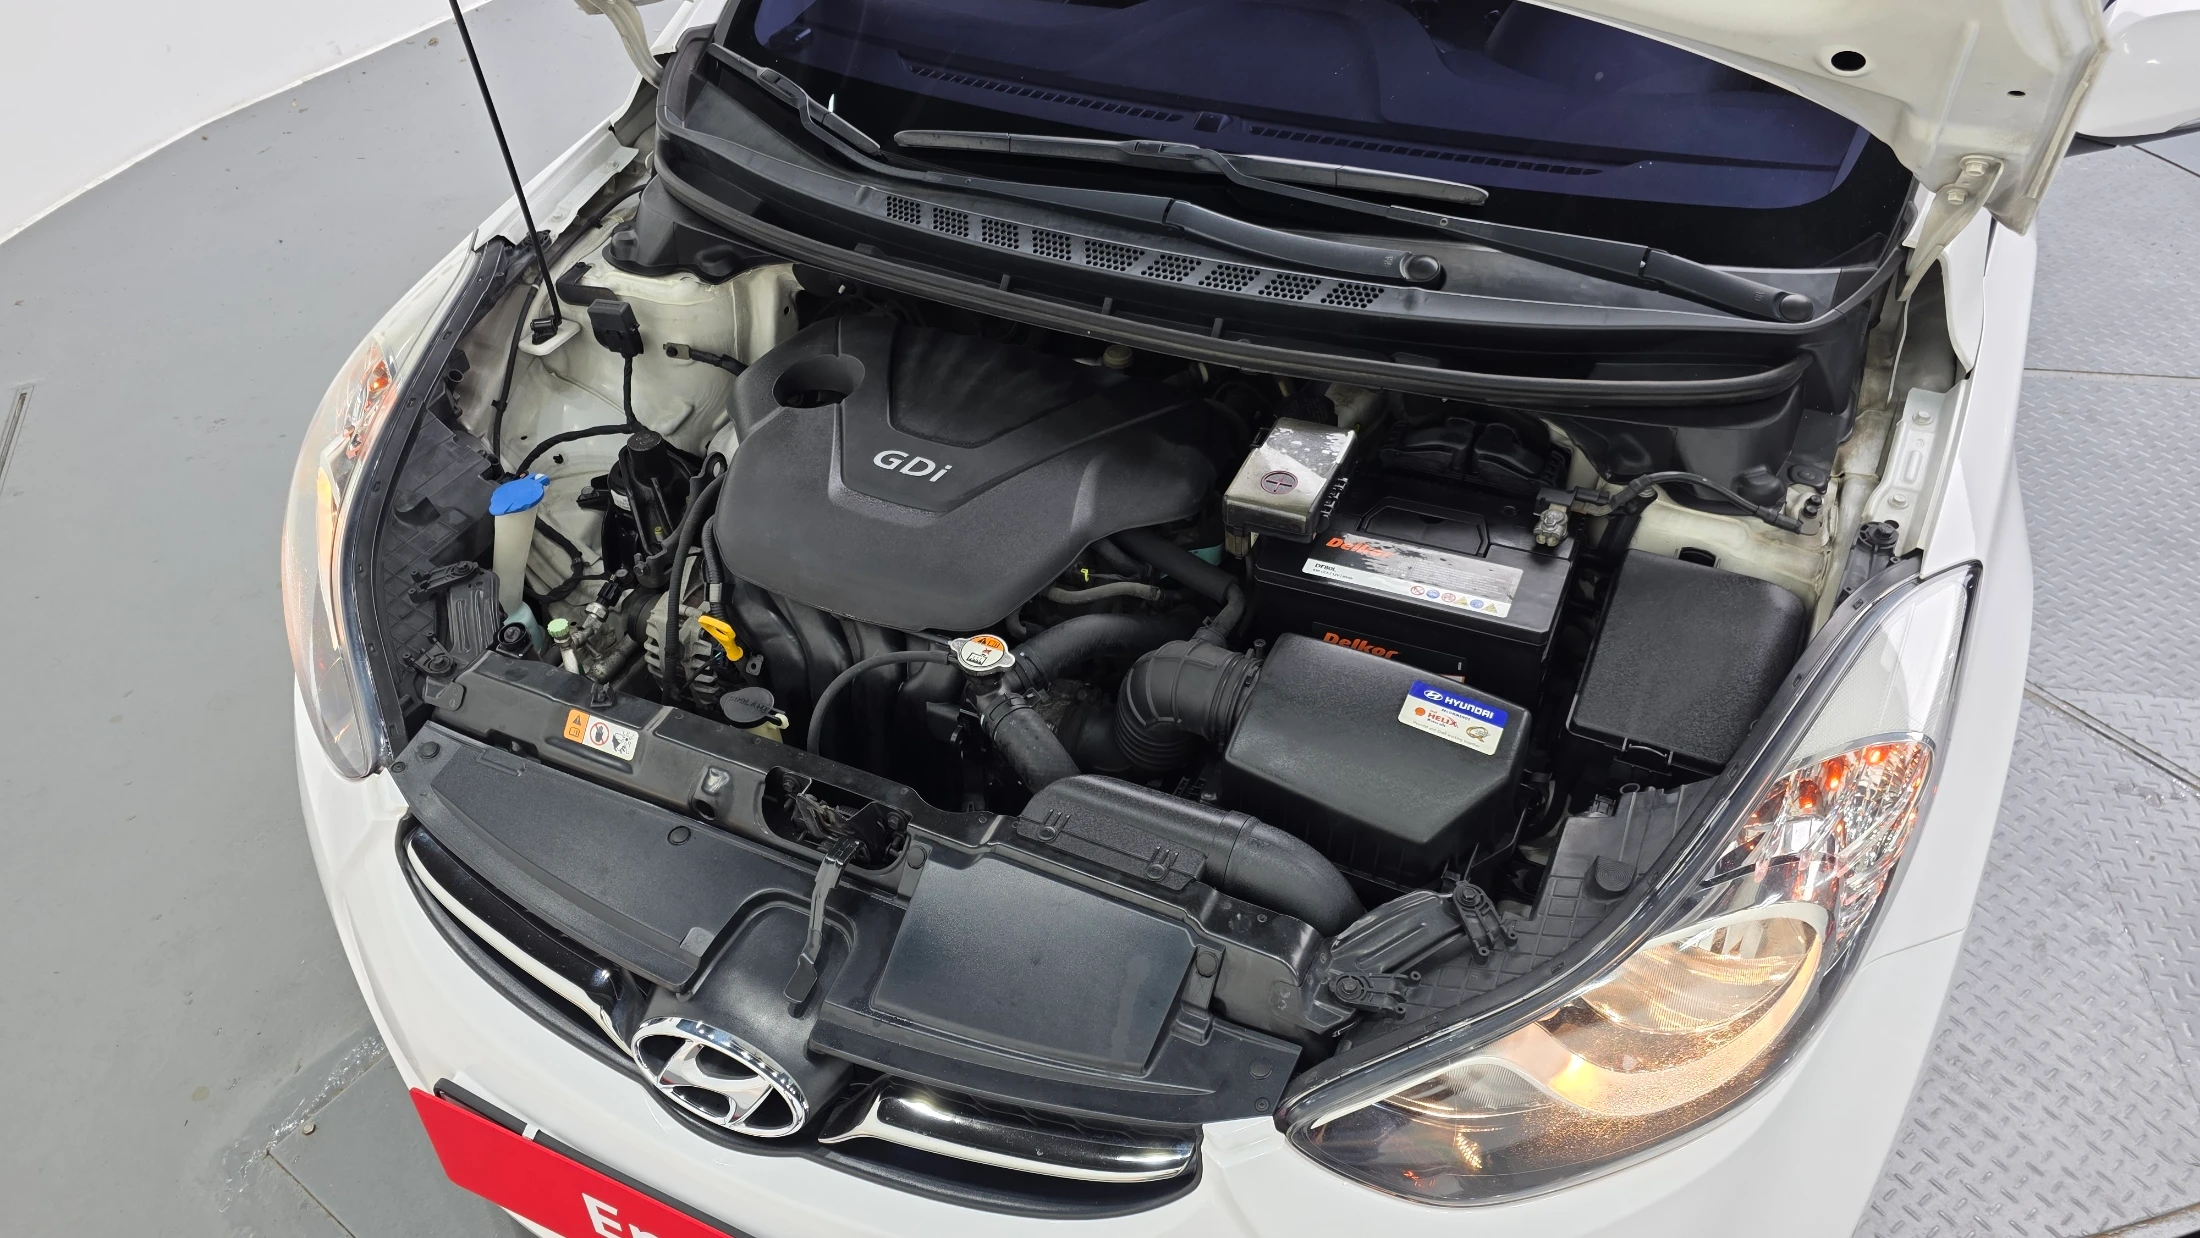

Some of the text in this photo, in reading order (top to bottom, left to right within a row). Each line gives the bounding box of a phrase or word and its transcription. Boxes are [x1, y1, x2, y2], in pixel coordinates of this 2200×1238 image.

[873, 450, 953, 483] GDi
[1325, 537, 1394, 559] Delkor
[1322, 632, 1399, 659] Delkor
[1444, 696, 1495, 719] HYUNDAI
[1427, 712, 1459, 728] HELIX
